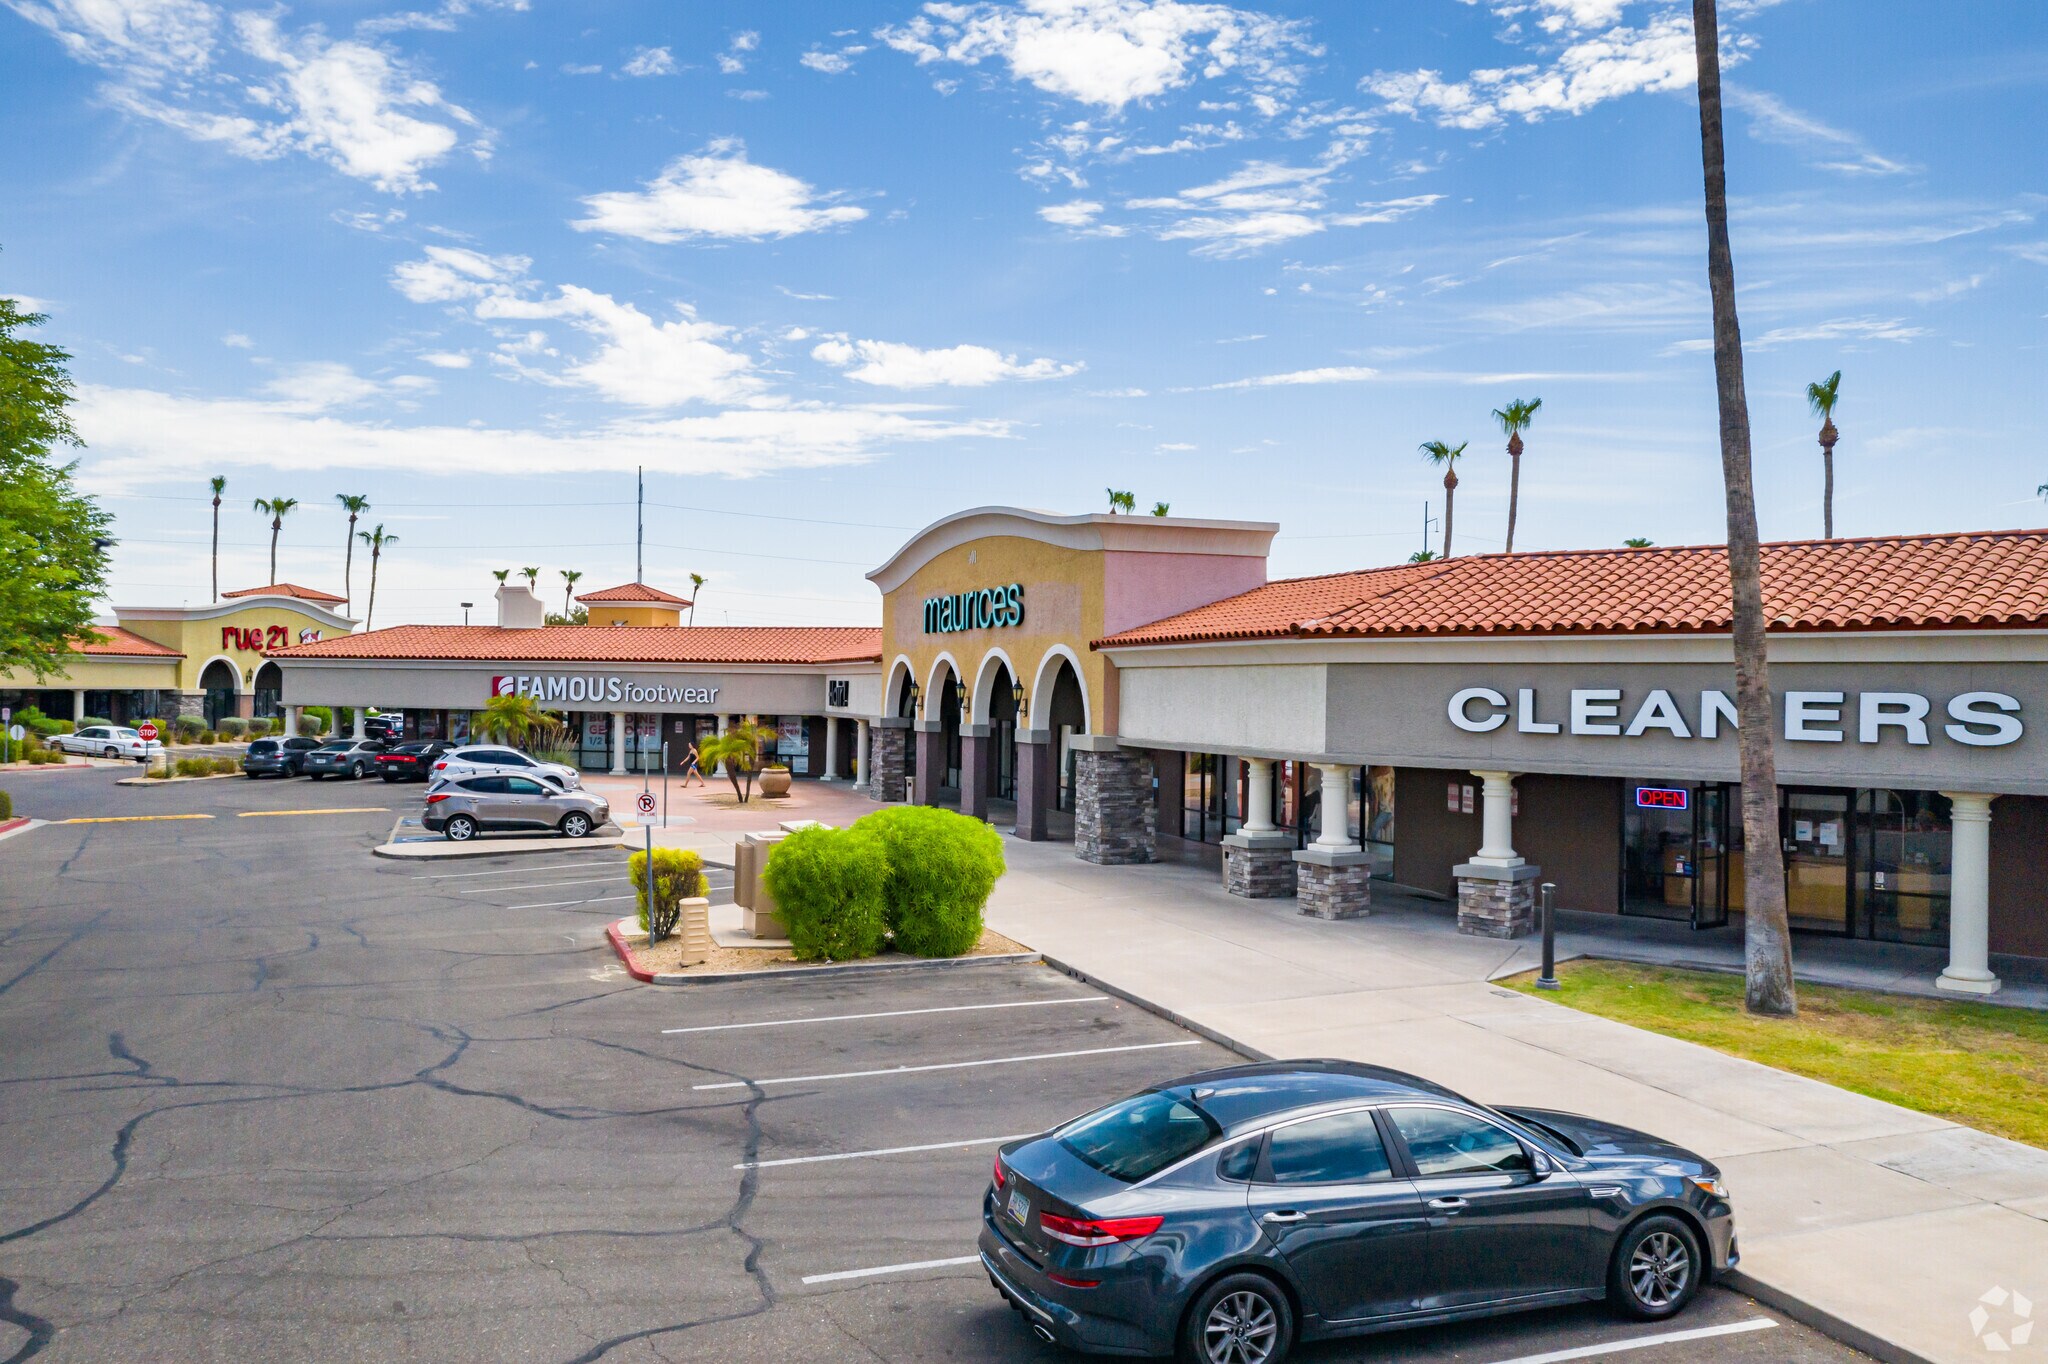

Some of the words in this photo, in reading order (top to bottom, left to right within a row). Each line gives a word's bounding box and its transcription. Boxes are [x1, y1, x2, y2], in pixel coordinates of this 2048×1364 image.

[923, 583, 1024, 634] maurices
[222, 626, 264, 651] rue
[267, 625, 288, 651] 21
[517, 676, 622, 702] FAMOUS
[624, 682, 720, 704] footwear
[1447, 687, 2024, 746] CLEANERS
[1639, 789, 1685, 807] OPEN
